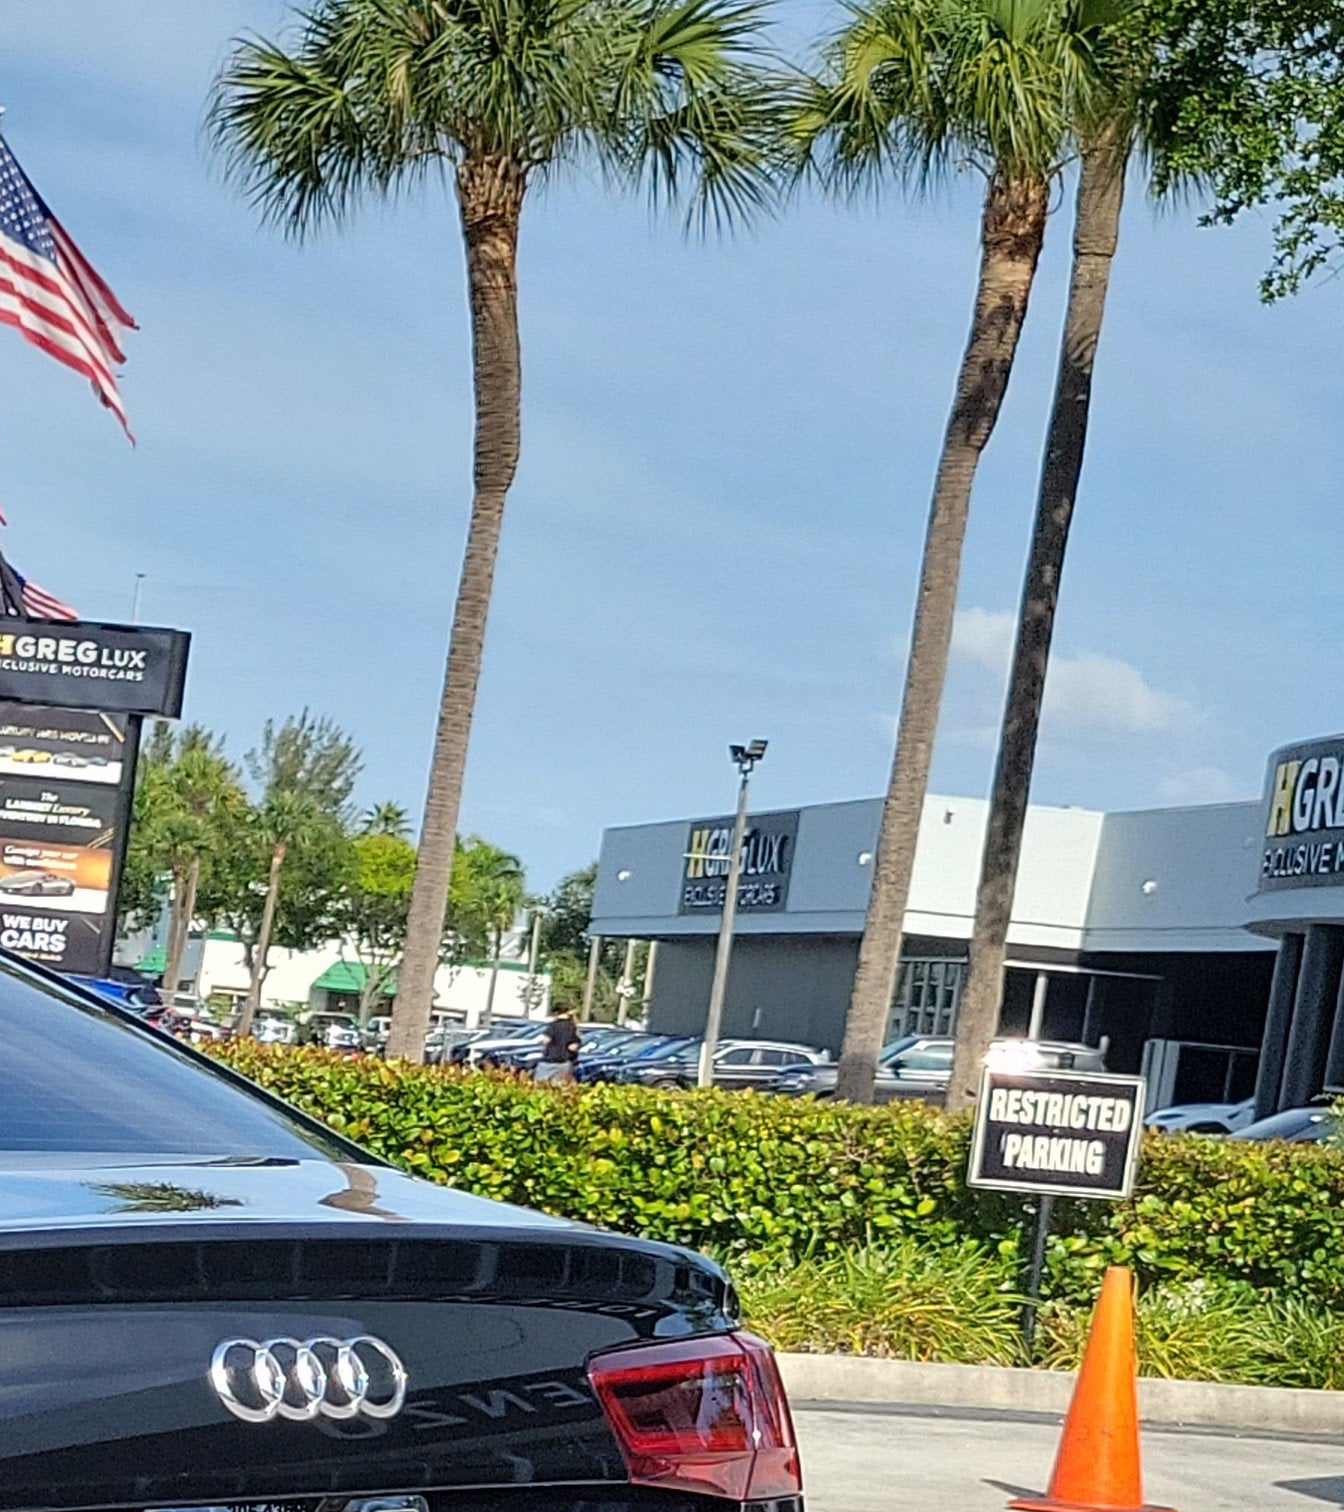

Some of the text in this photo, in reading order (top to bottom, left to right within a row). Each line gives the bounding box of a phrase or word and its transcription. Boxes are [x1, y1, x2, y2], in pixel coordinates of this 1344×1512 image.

[101, 649, 147, 669] LUX
[62, 665, 144, 682] MOTORCARS
[2, 914, 69, 932] WE BUY
[0, 929, 66, 953] CARS
[989, 1087, 1132, 1133] RESTRICTED
[1002, 1133, 1105, 1175] PARKING
